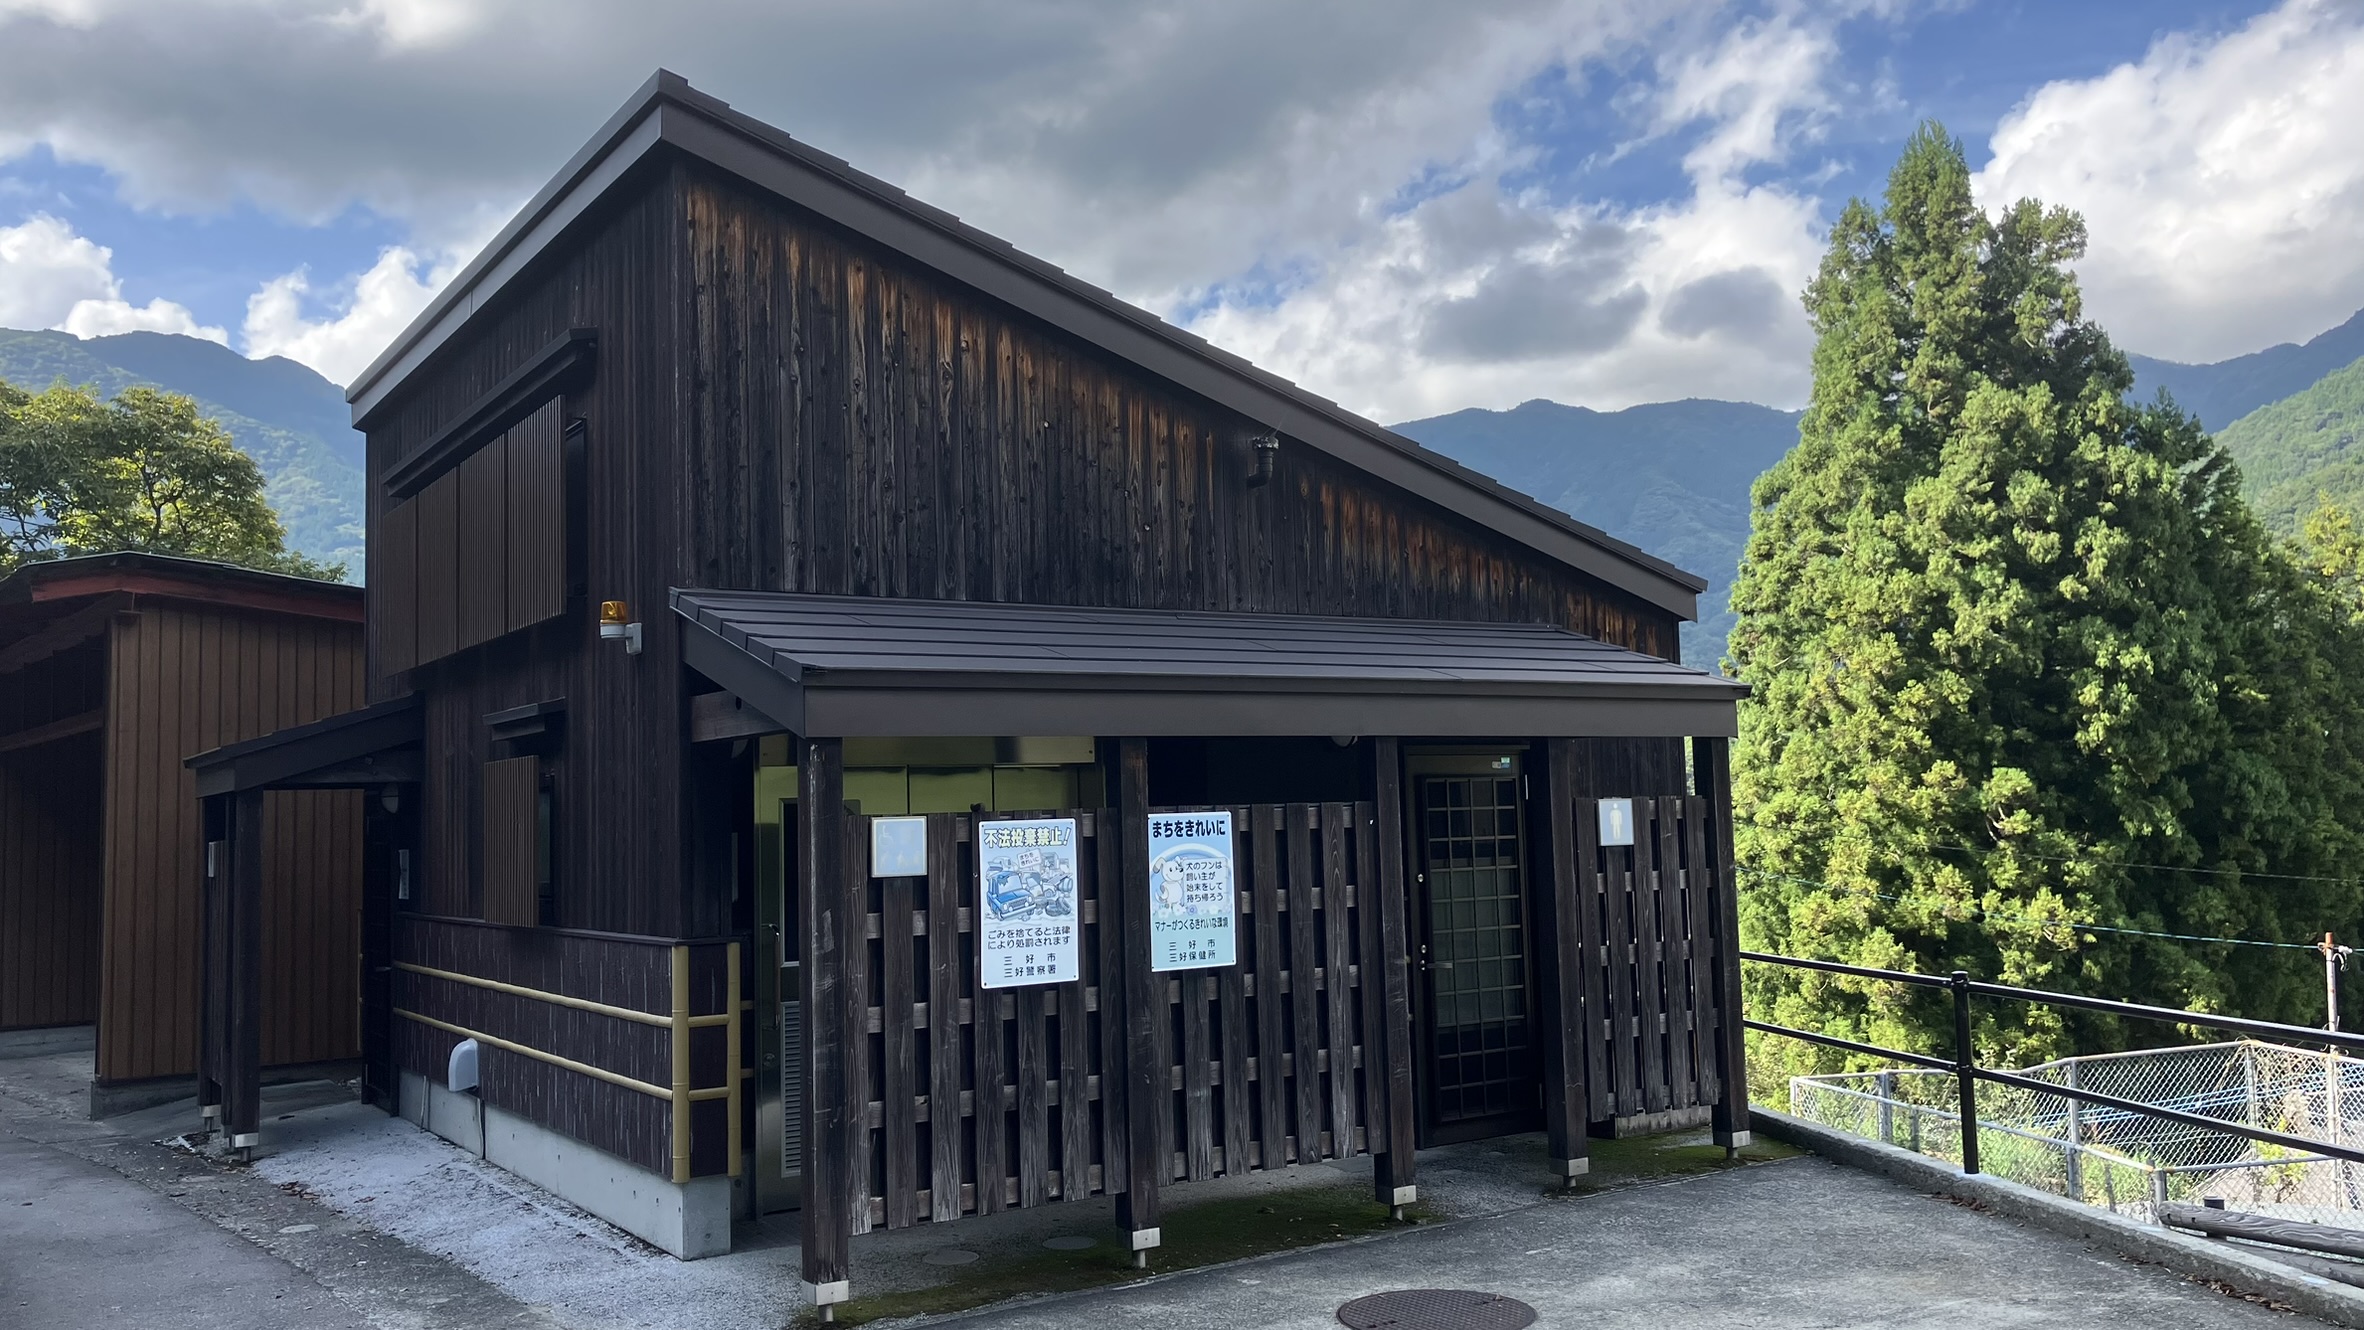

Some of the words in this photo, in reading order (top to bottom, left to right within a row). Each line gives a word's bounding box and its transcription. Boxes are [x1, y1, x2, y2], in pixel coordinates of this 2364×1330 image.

[1152, 820, 1226, 838] まちをきれいに
[1186, 861, 1222, 871] 犬のフンは
[1186, 872, 1216, 881] 飼い主が
[1186, 882, 1223, 892] 始末をして
[1186, 893, 1224, 903] 持ち帰ろう
[1155, 917, 1229, 932] マナーがつくるきれいな環境
[988, 926, 1071, 940] ごみを捨てると法律
[988, 935, 1071, 950] により処罰されます
[1169, 950, 1216, 963] 三好保健所
[1004, 964, 1056, 978] 三好警察署
